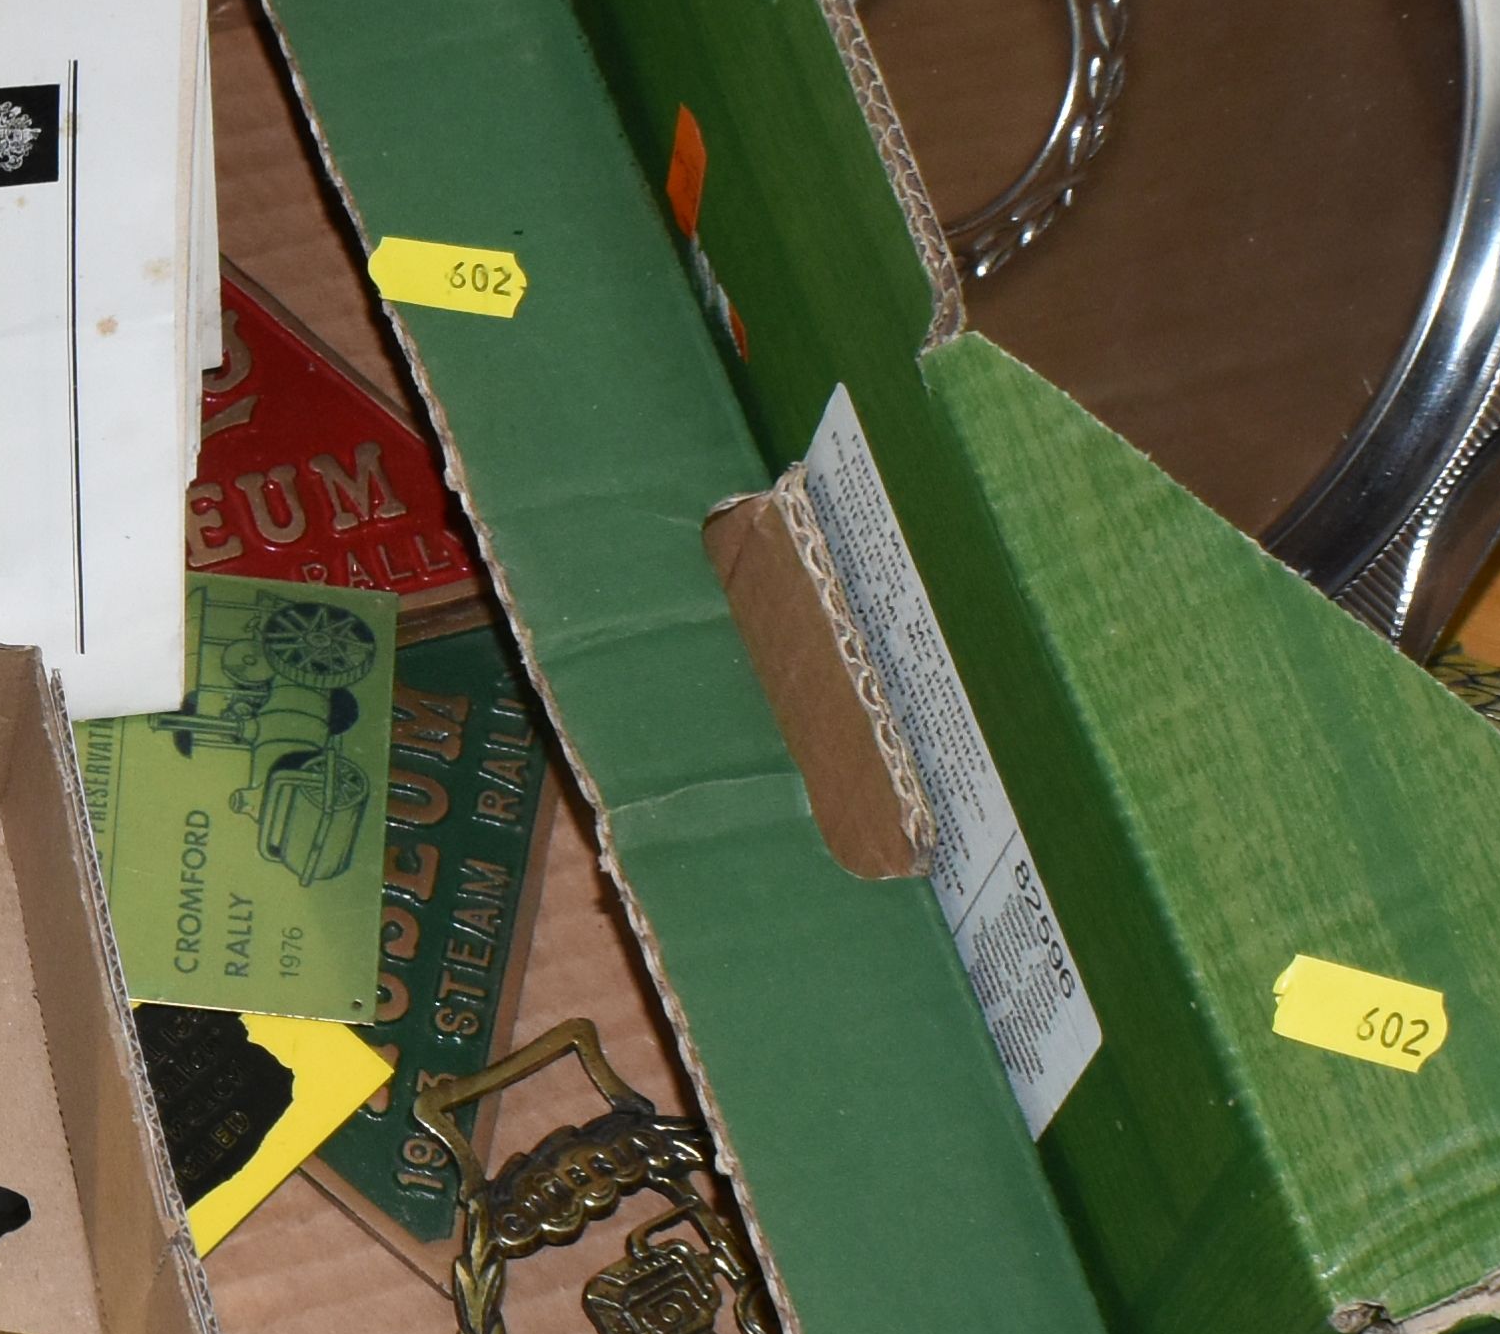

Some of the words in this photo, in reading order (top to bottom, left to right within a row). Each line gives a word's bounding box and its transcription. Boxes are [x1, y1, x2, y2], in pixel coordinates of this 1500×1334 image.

[450, 260, 511, 297] 602
[175, 810, 211, 975] CROMFORD
[1011, 859, 1076, 1002] 82596
[224, 893, 254, 979] RALLY
[279, 927, 303, 980] 1976
[436, 858, 510, 1045] STEAM
[1357, 1007, 1429, 1057] 602
